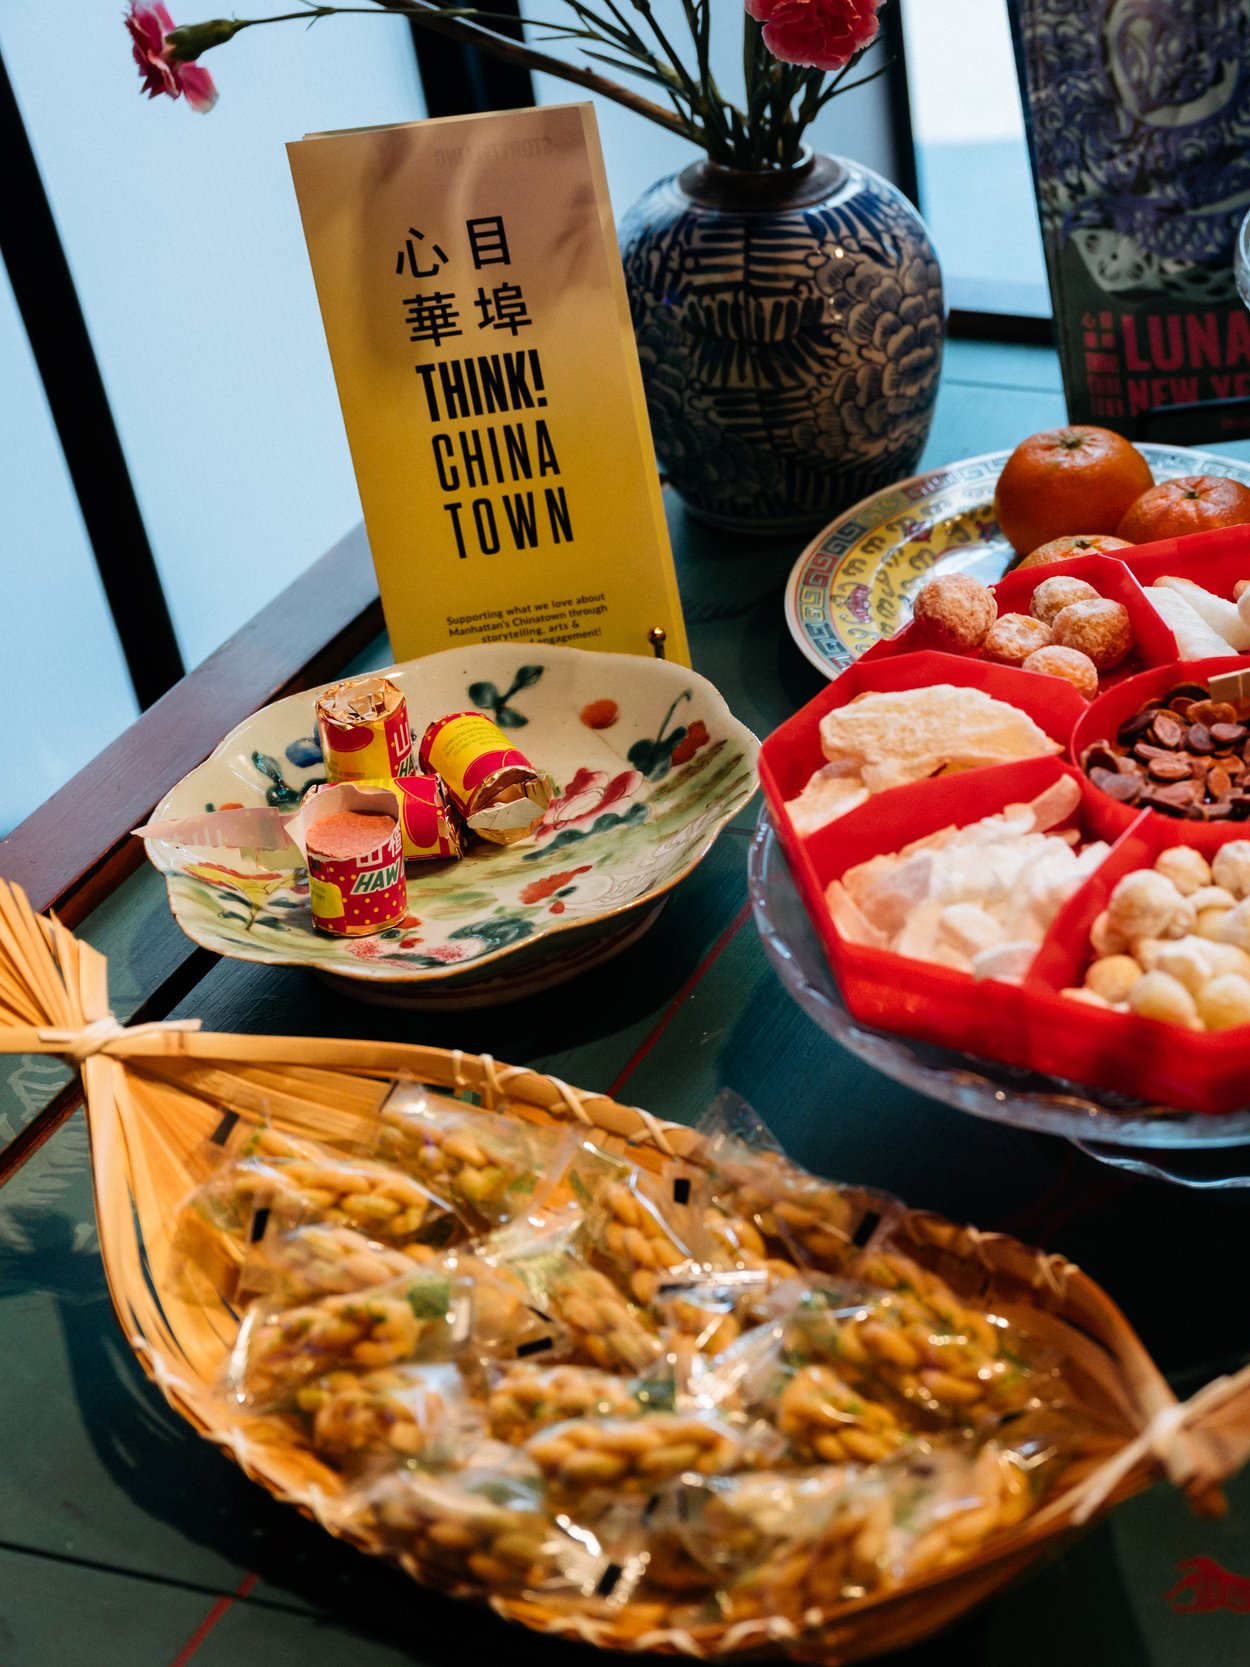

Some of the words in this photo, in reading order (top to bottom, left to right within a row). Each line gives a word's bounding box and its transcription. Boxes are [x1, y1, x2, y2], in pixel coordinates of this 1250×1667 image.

[395, 215, 511, 279] 心目
[403, 282, 532, 348] 華埠
[415, 349, 548, 422] THINK!
[1127, 376, 1198, 416] NEW
[432, 420, 561, 493] CHINA
[444, 487, 574, 559] TOWN
[446, 611, 503, 625] Supporting
[506, 605, 531, 616] what
[534, 602, 549, 612] we
[552, 598, 573, 609] love
[576, 593, 605, 605] about
[512, 612, 566, 627] Chinatown
[568, 605, 608, 618] through
[548, 623, 568, 633] arts
[571, 620, 580, 628] &
[352, 862, 398, 893] HAW
